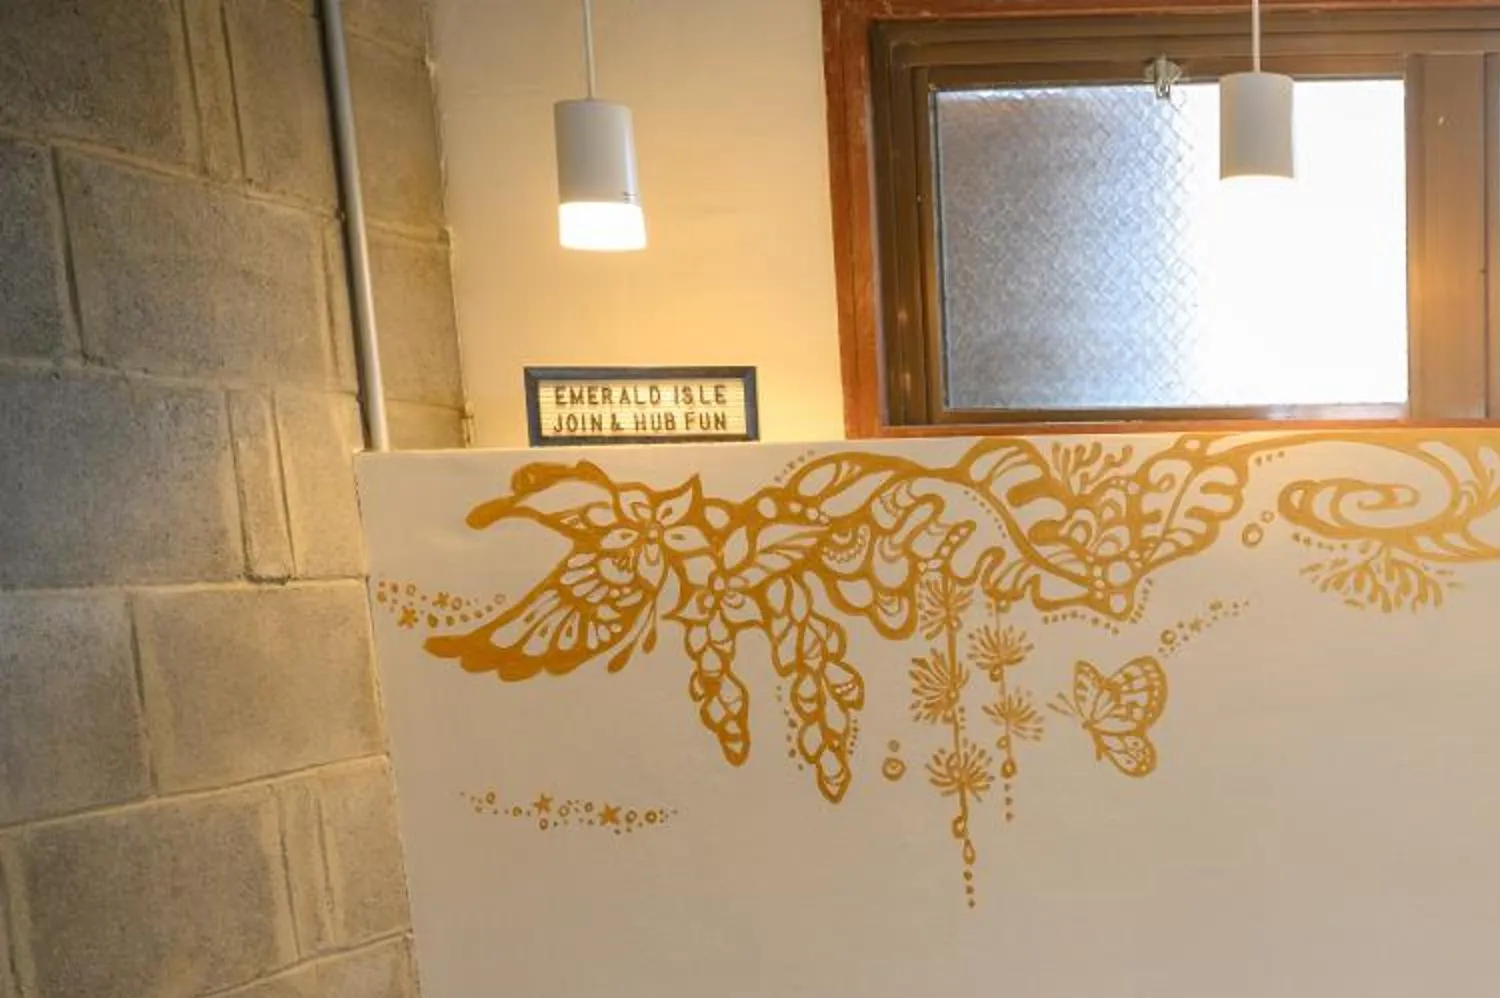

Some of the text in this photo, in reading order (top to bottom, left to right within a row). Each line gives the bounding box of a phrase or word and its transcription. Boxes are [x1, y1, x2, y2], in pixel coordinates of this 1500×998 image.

[555, 385, 728, 406] EMERALD ISLE
[554, 411, 727, 433] JOIN & HUB FUN
